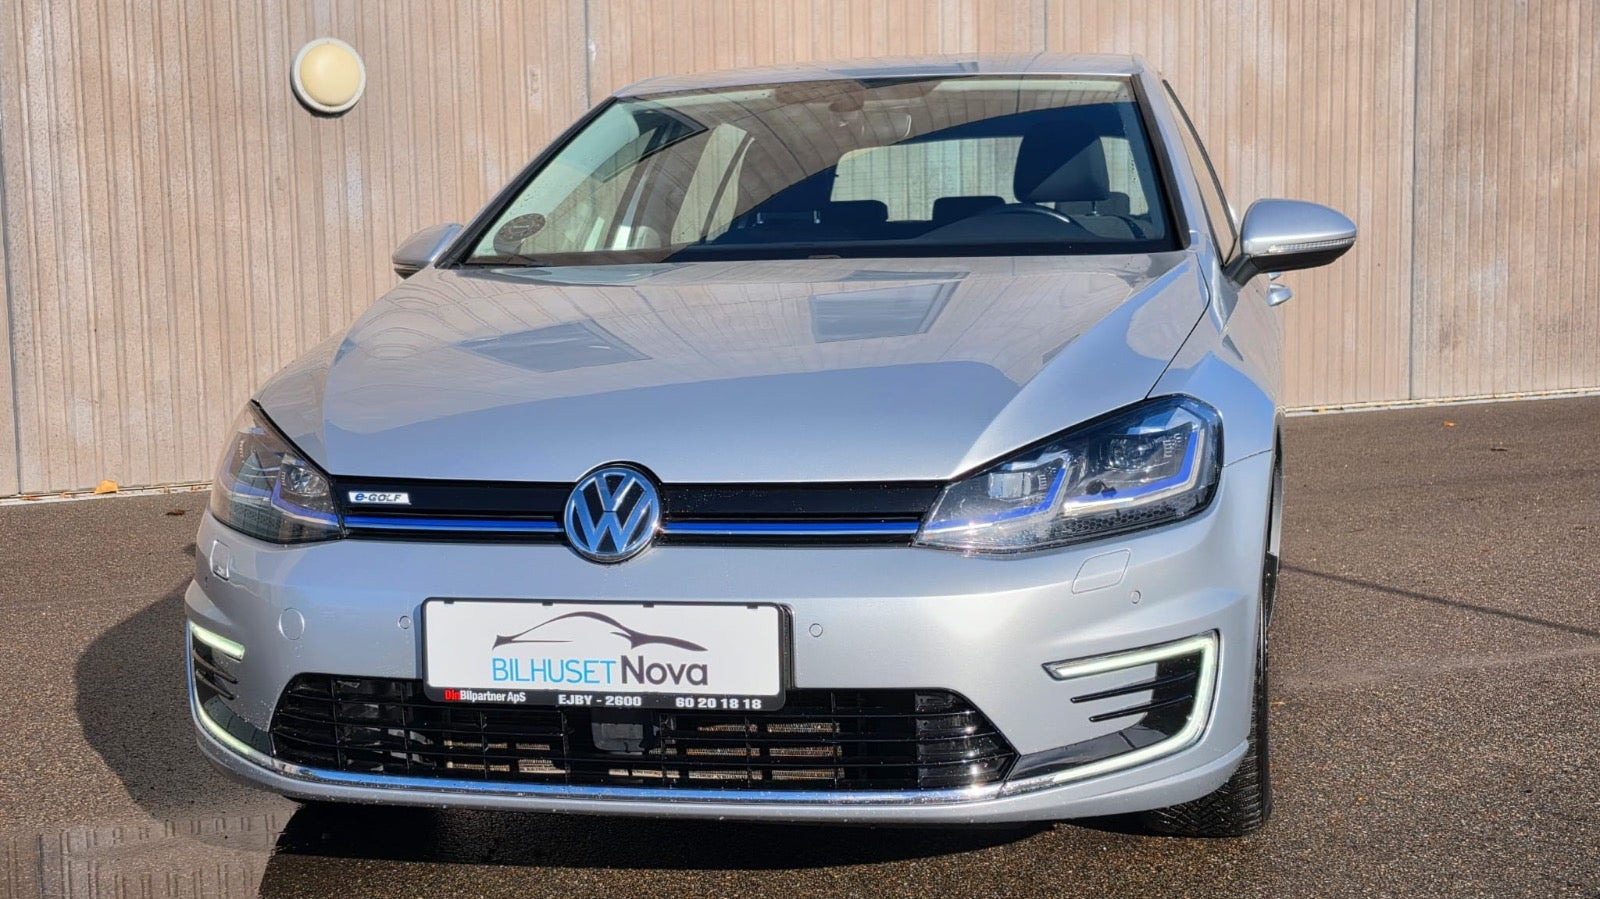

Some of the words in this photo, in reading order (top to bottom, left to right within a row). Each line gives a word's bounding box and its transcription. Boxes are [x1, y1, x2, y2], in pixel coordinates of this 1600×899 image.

[354, 491, 402, 502] e-GOLF
[492, 658, 616, 684] BILHUSET
[620, 655, 708, 686] Nova
[507, 691, 526, 703] ApS
[558, 694, 593, 706] EJBY
[605, 695, 641, 707] 2600
[676, 697, 695, 708] 60
[698, 697, 717, 709] 20
[720, 697, 739, 709] 18
[742, 698, 762, 710] 18
